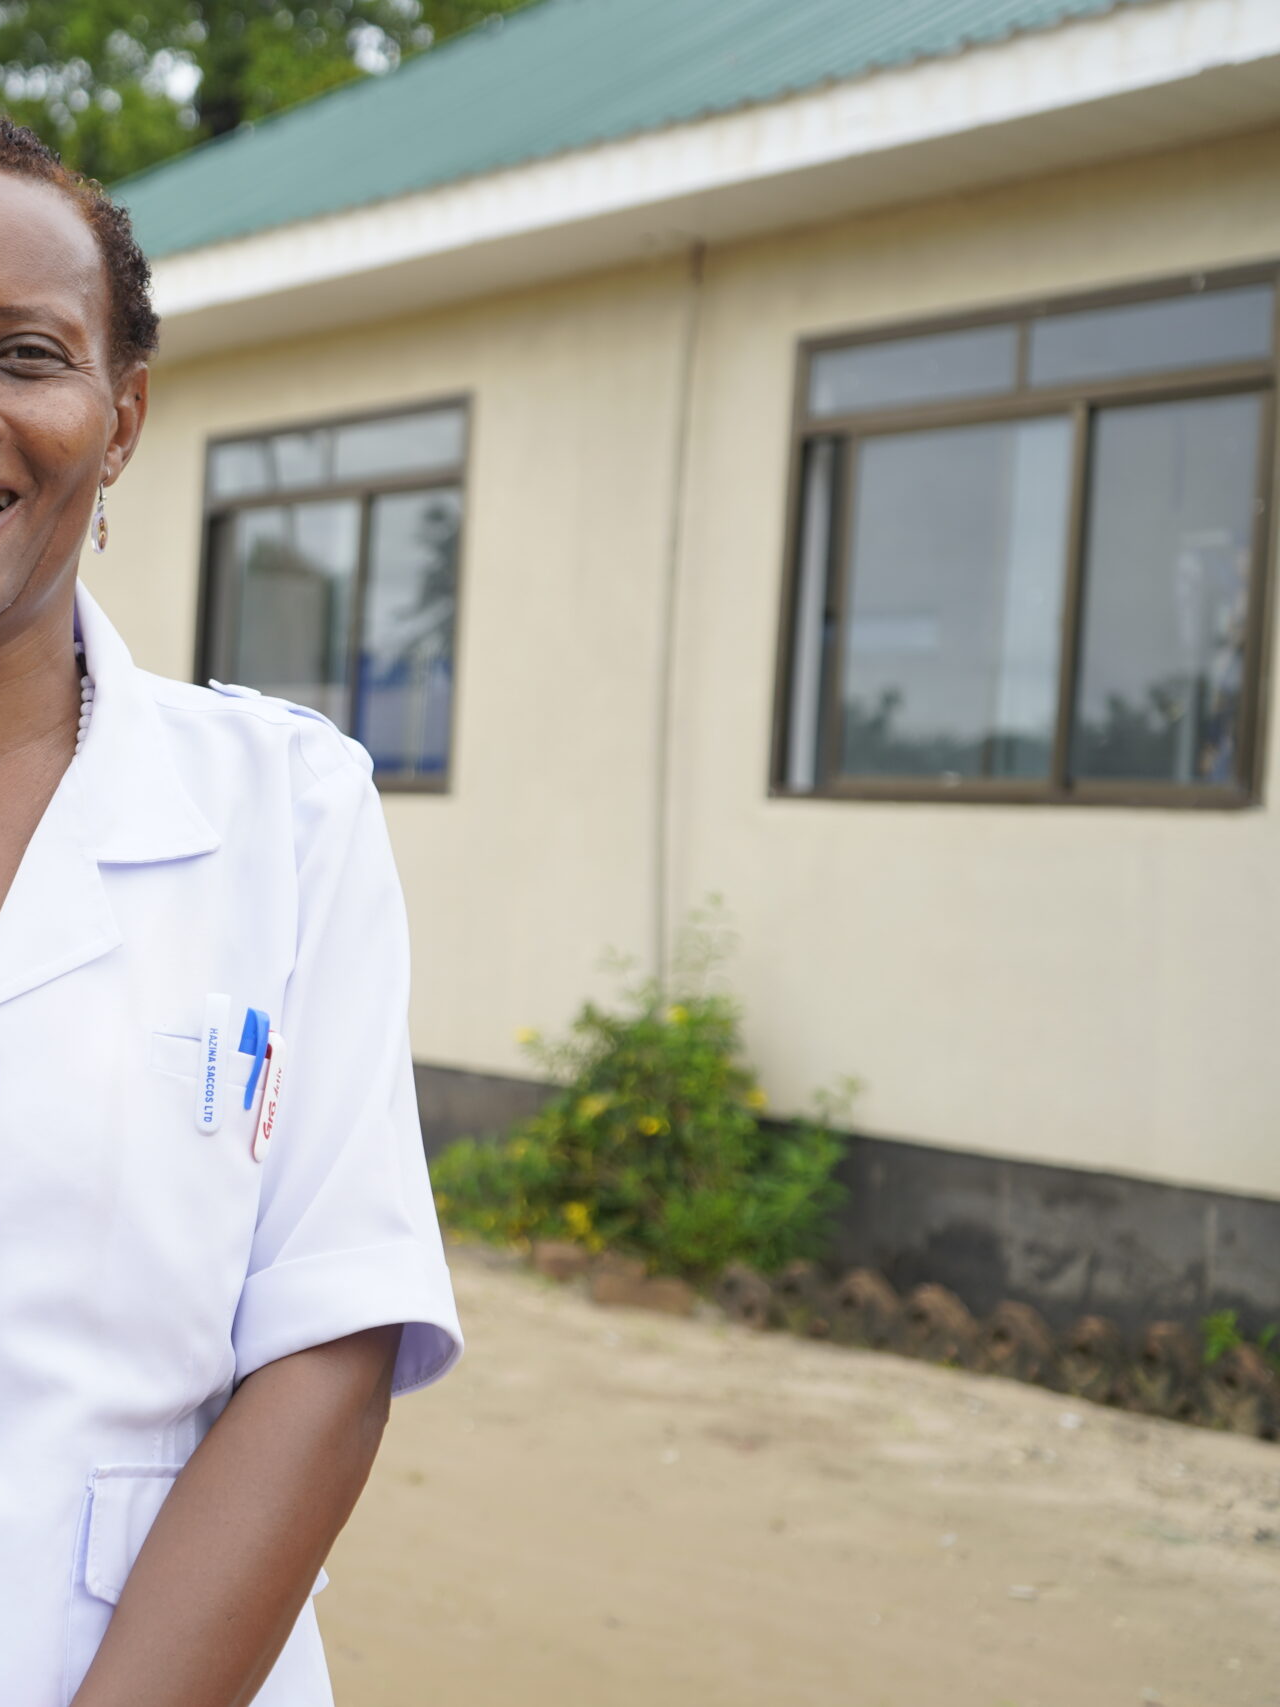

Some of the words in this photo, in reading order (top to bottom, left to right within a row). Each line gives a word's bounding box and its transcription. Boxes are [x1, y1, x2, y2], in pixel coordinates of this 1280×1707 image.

[207, 1027, 219, 1063] HAZINA
[205, 1065, 217, 1103] SACCOS
[203, 1105, 214, 1124] LTD
